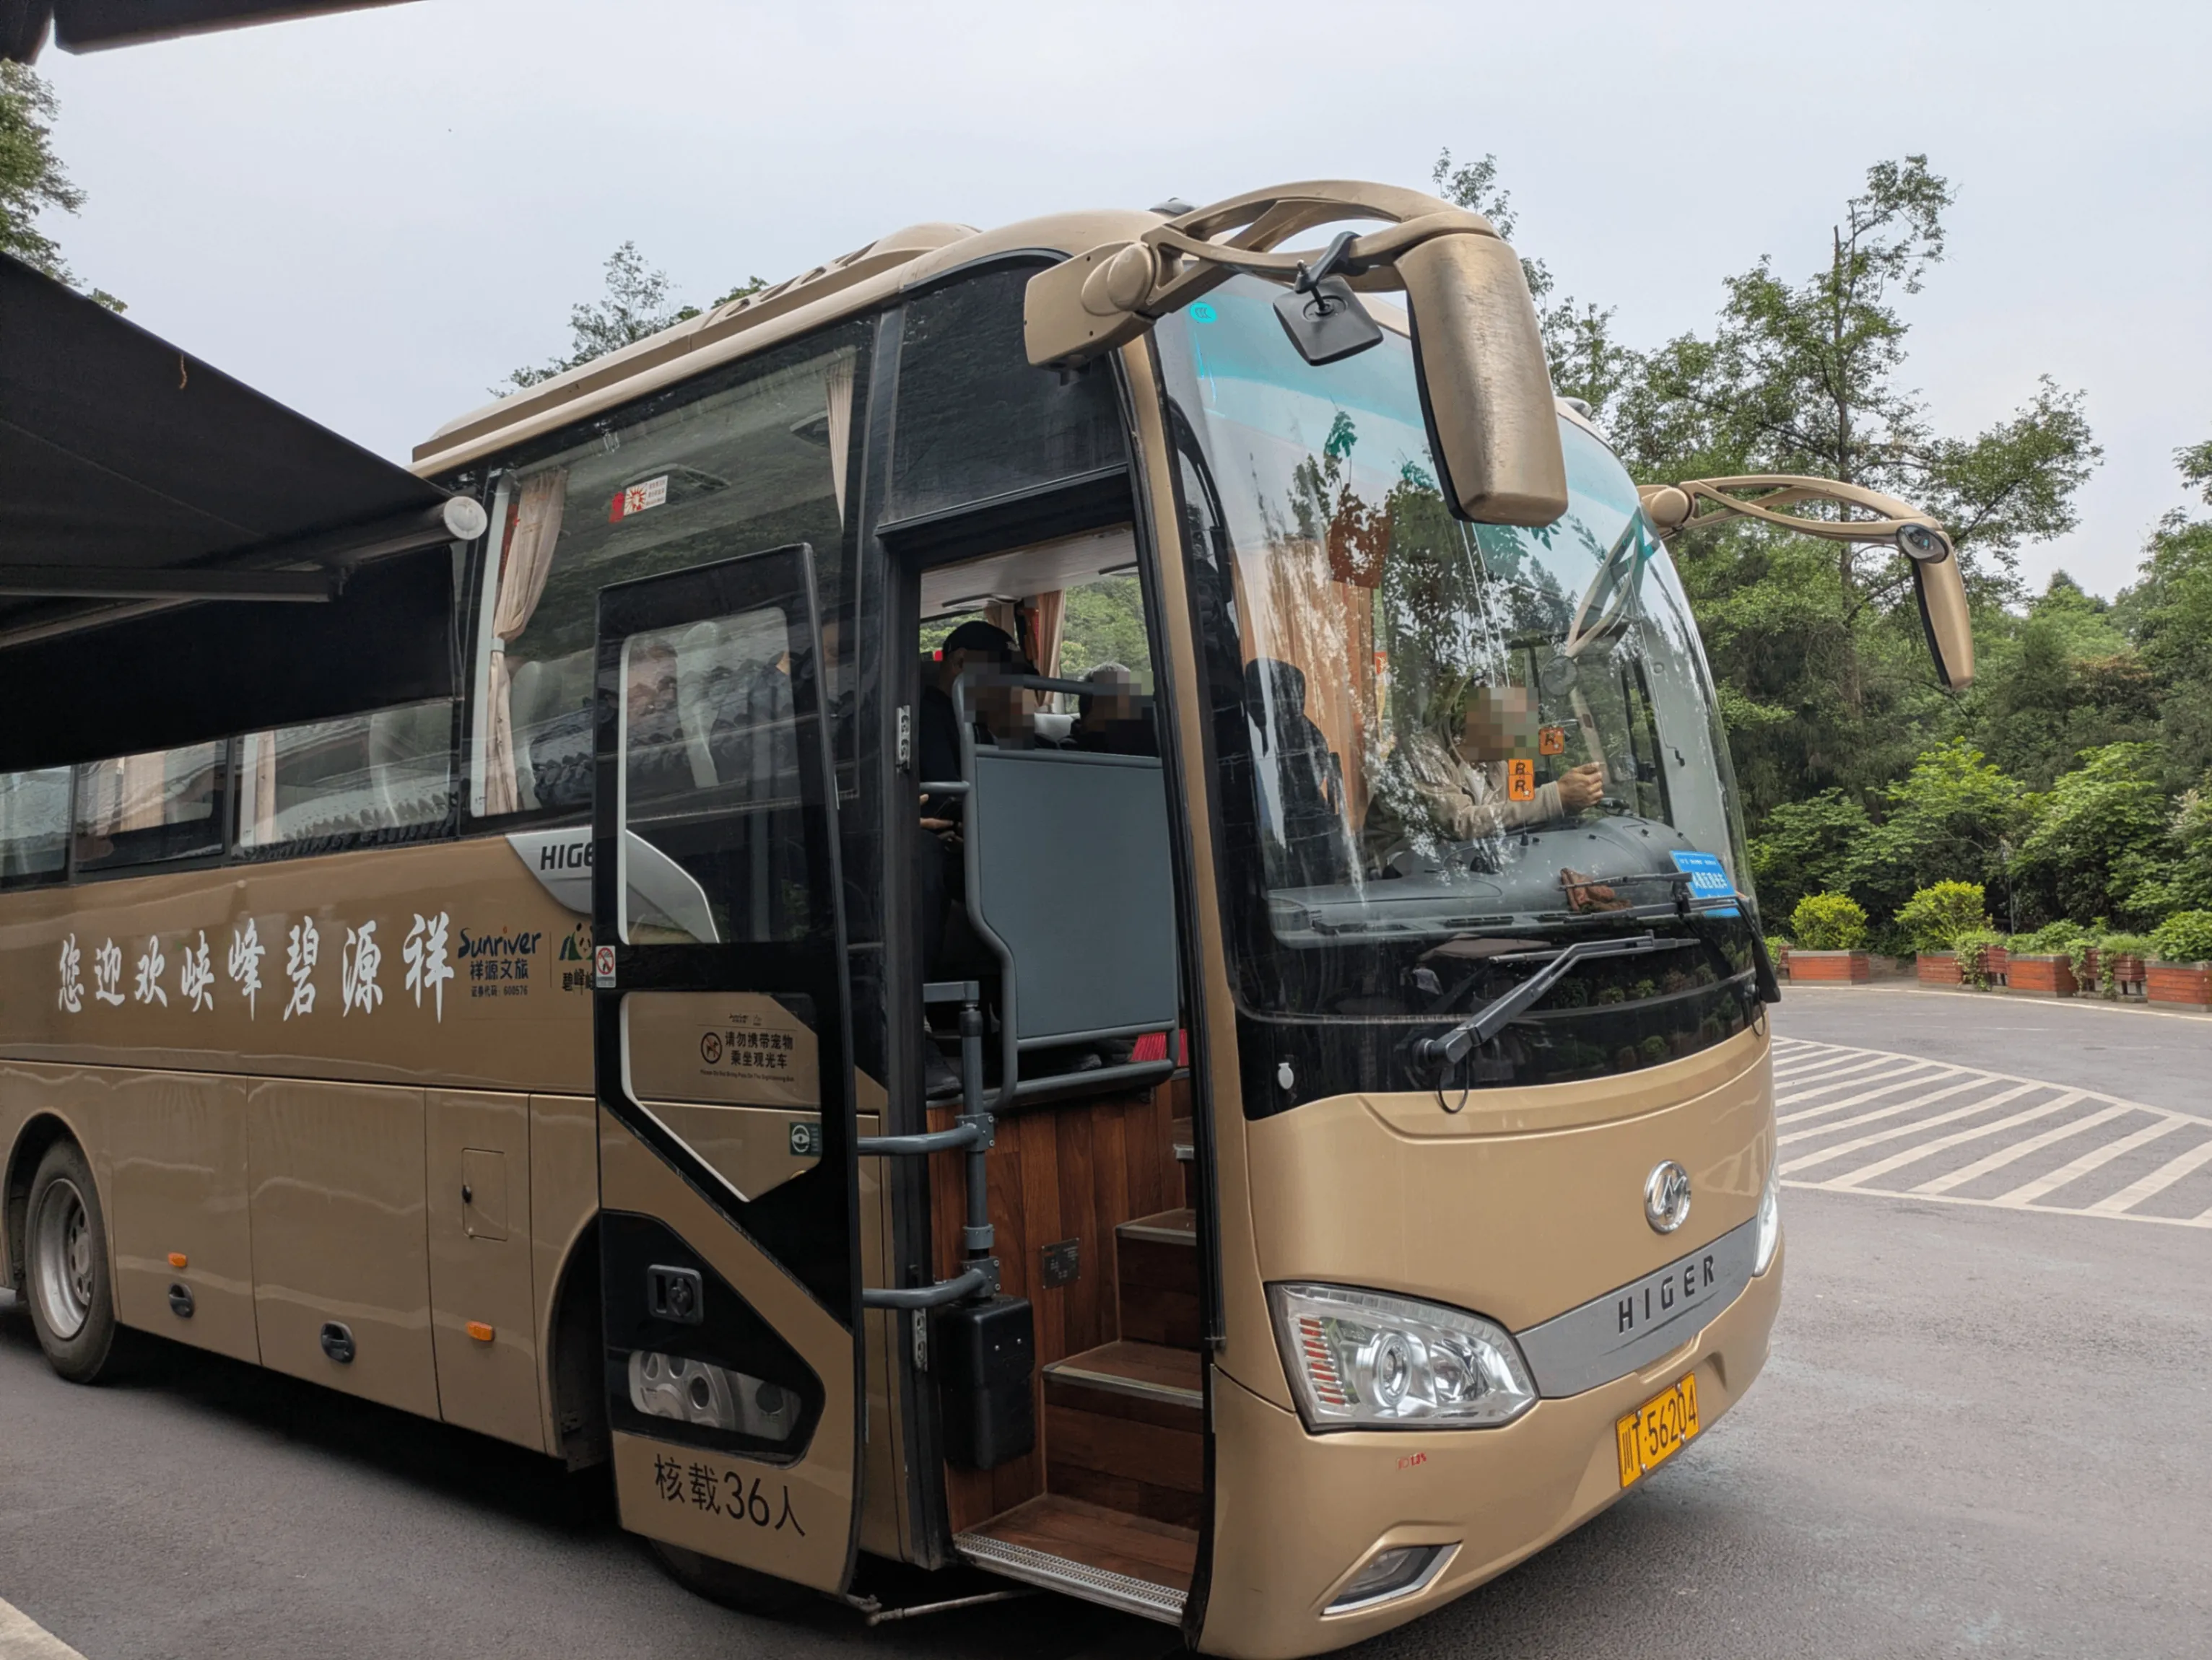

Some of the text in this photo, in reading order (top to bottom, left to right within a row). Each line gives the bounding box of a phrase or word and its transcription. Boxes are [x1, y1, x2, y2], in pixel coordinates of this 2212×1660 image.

[458, 926, 541, 959] Sunriver
[470, 958, 528, 980] 祥源文旅
[725, 1031, 793, 1051] 请勿携带宠物
[731, 1050, 788, 1069] 乘坐观光车
[1619, 1254, 1715, 1334] HIGER
[655, 1454, 805, 1537] 核载36人
